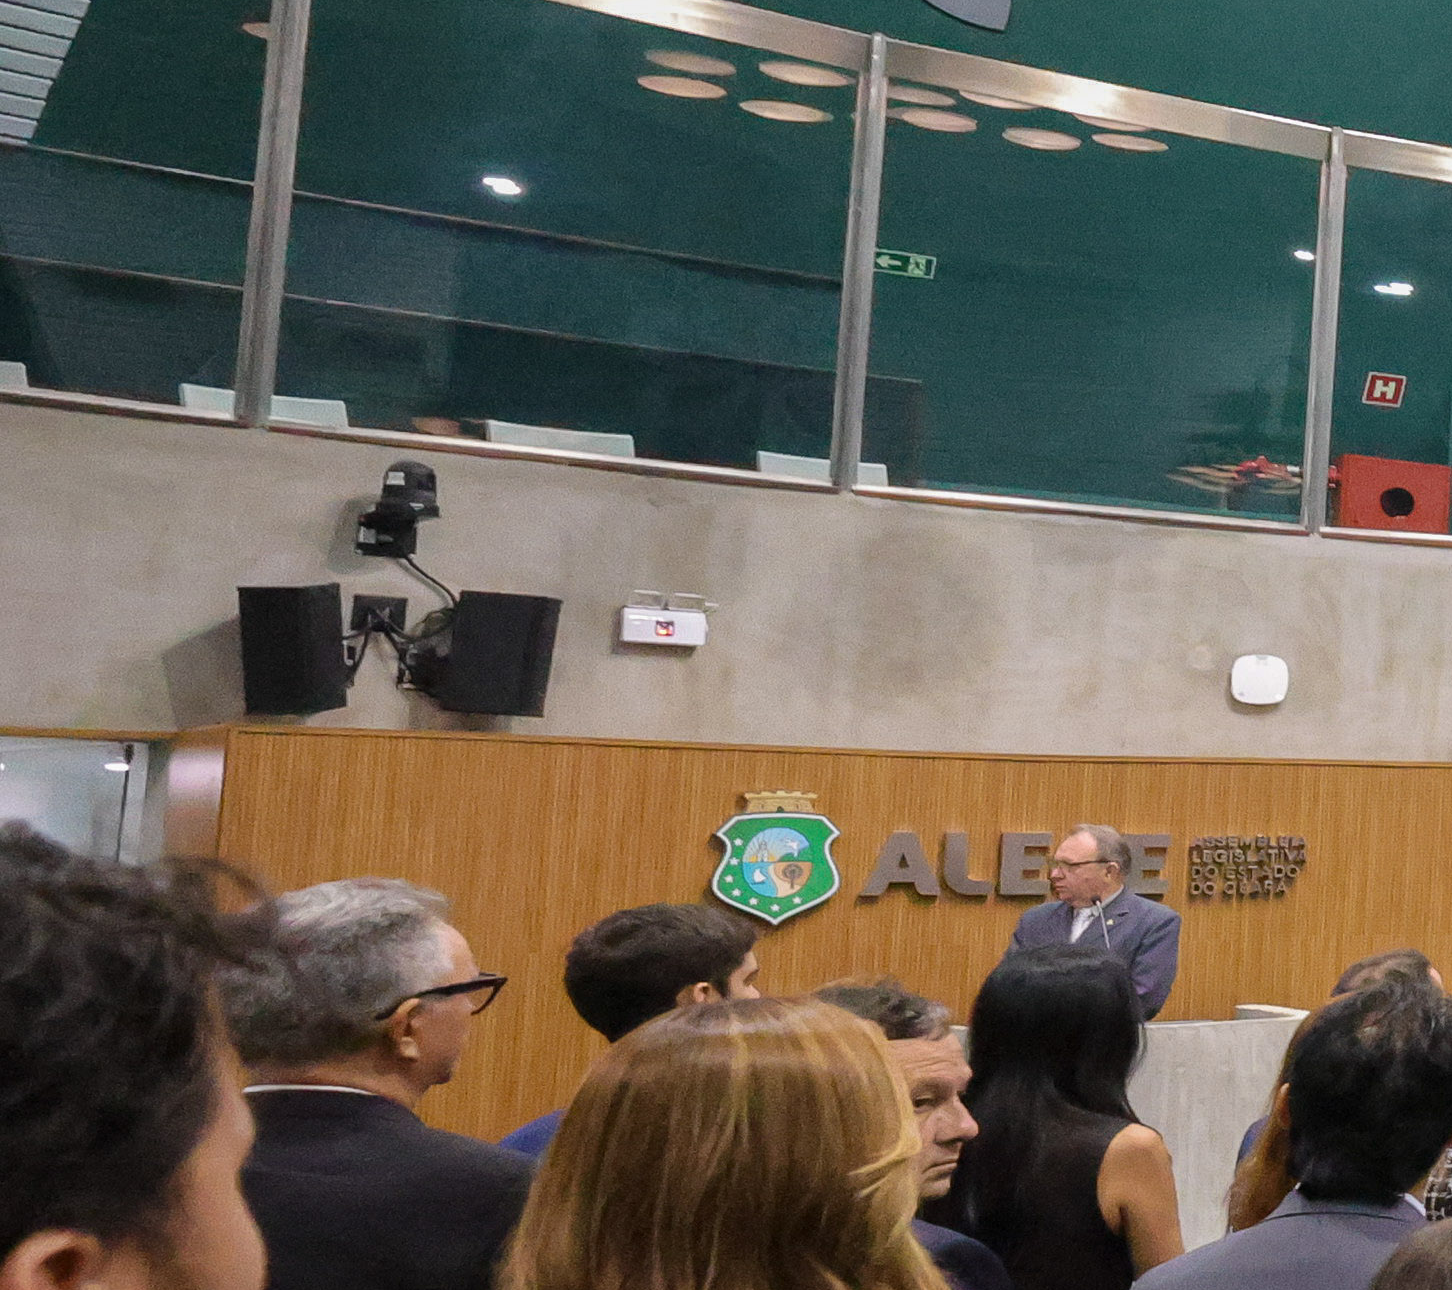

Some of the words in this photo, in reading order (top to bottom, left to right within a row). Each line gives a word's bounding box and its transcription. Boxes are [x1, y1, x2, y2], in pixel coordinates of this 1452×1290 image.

[1372, 379, 1397, 399] H
[1190, 836, 1305, 848] ASSEMBLEIA
[1191, 849, 1306, 863] LEGISLATIVA
[858, 830, 1171, 897] ALEE
[1191, 865, 1218, 879] DO
[1225, 865, 1300, 879] ESTADO
[1190, 881, 1216, 895] DO
